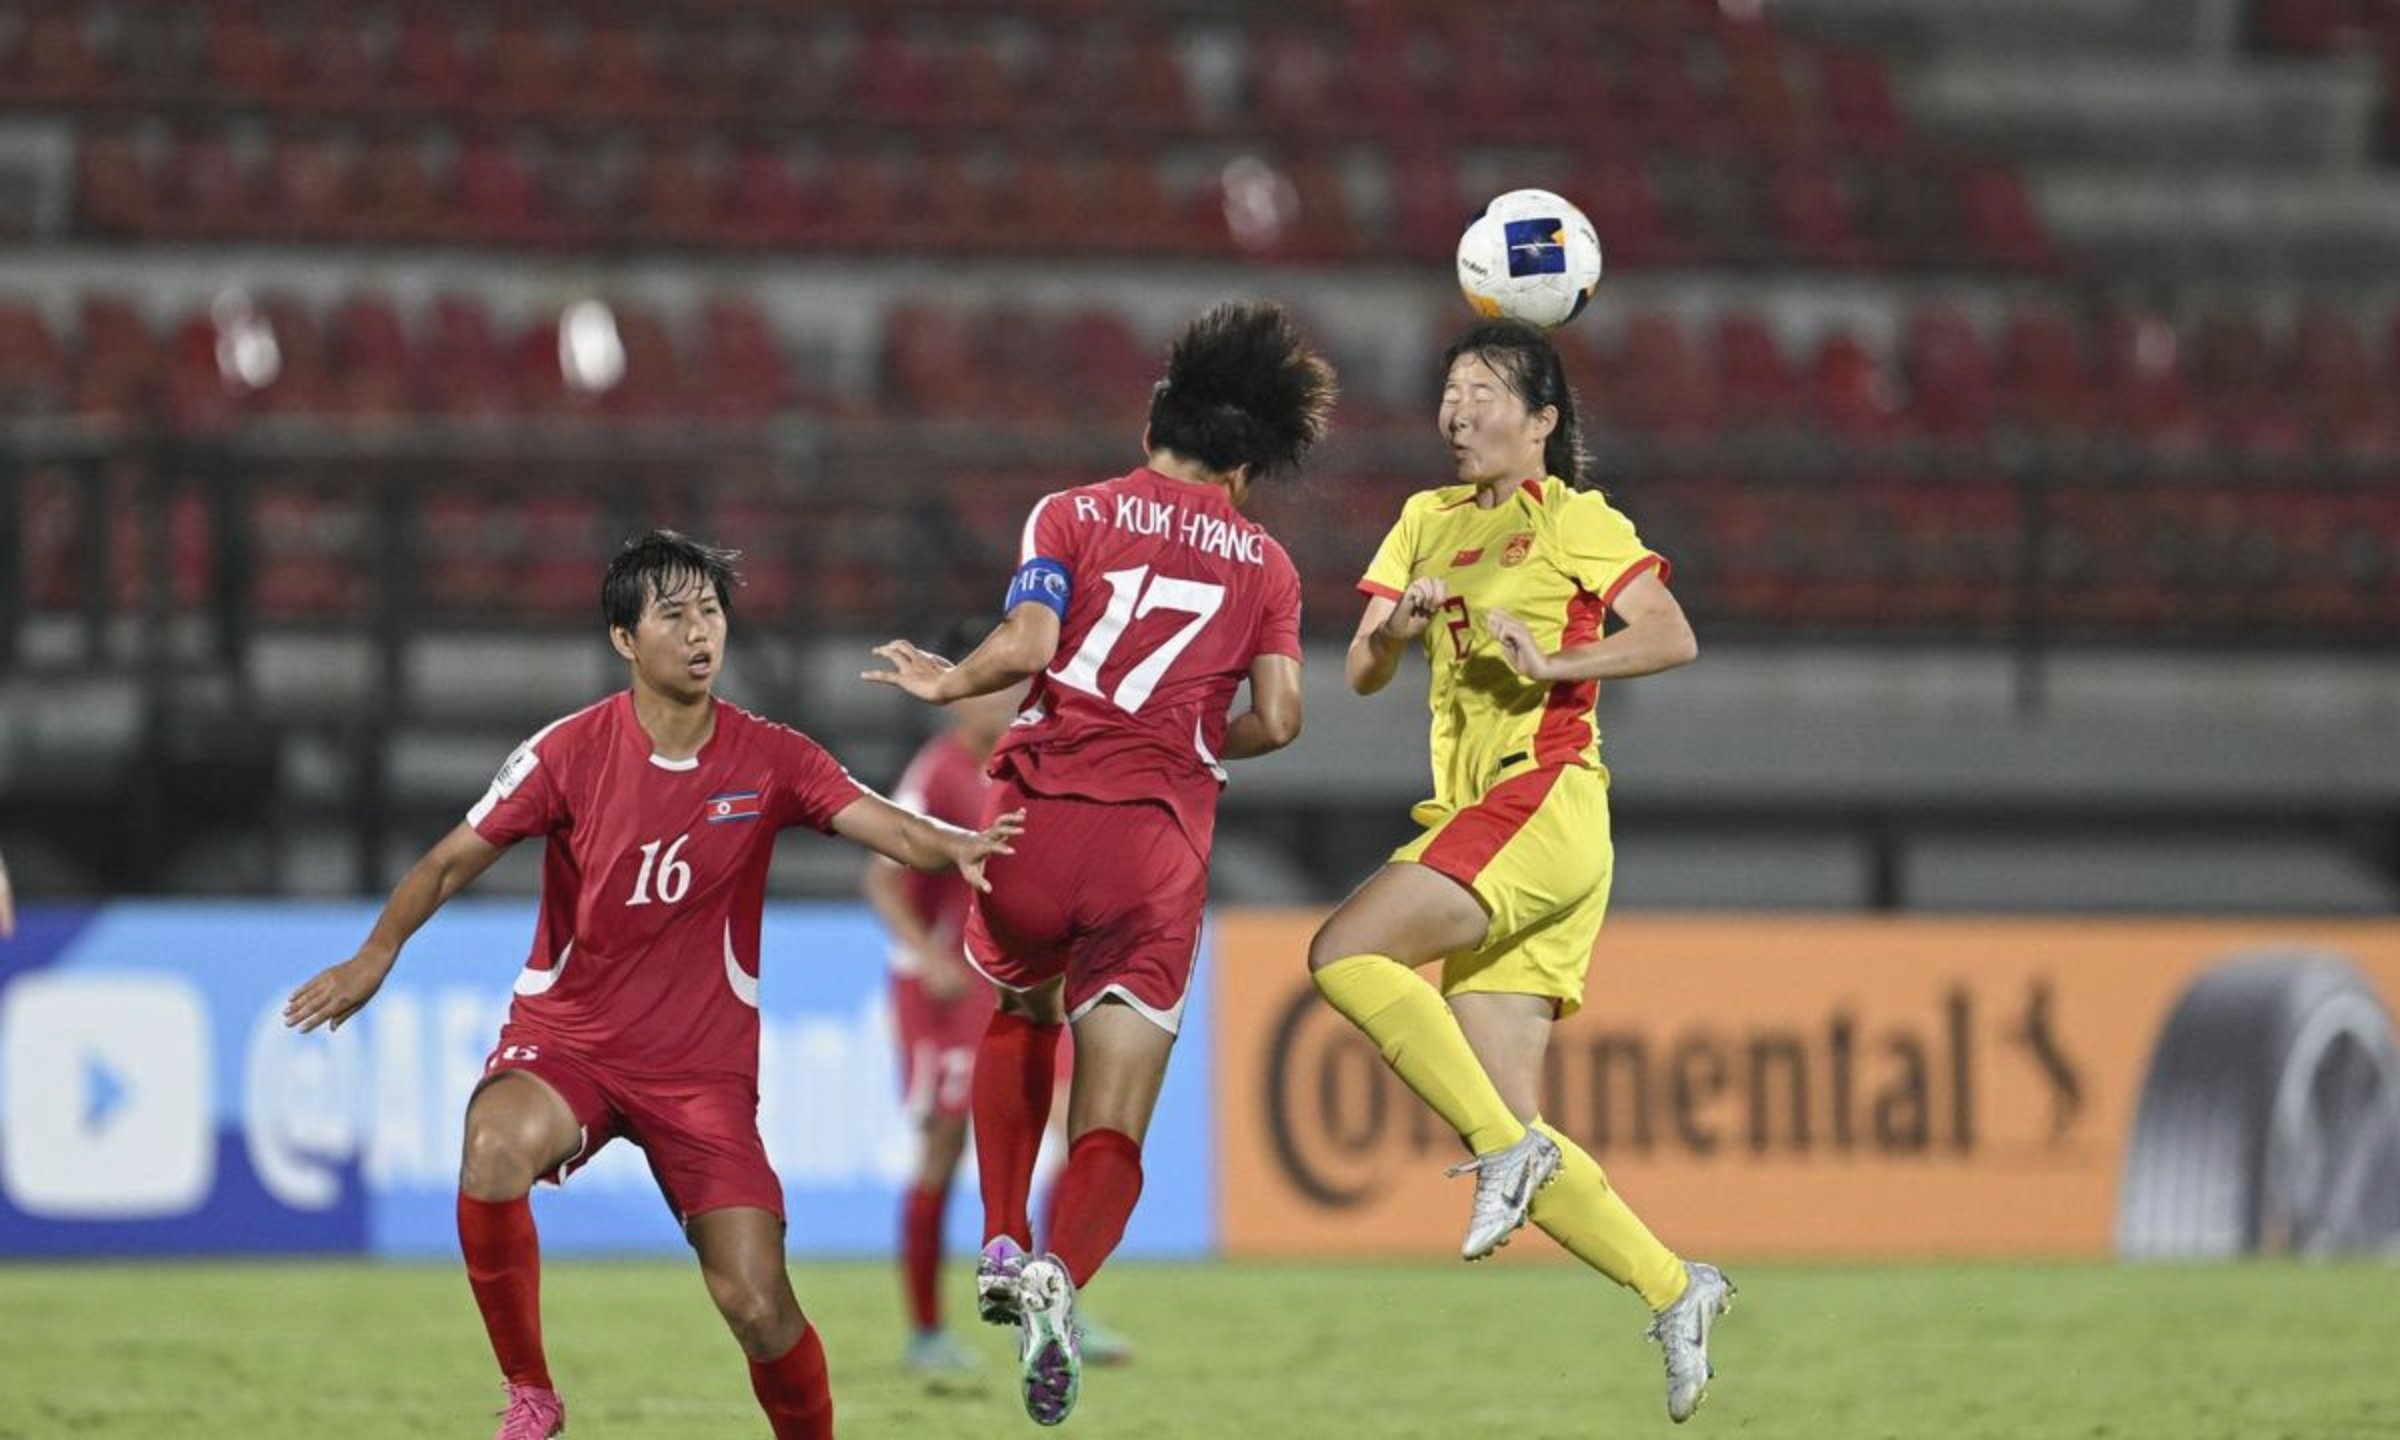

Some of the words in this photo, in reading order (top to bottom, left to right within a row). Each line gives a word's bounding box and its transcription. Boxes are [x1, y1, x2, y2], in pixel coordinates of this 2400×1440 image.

[1074, 494, 1108, 524] R.
[1115, 493, 1175, 541] KUK
[1179, 507, 1265, 566] HYANG
[1045, 563, 1226, 715] 17
[625, 833, 692, 907] 16
